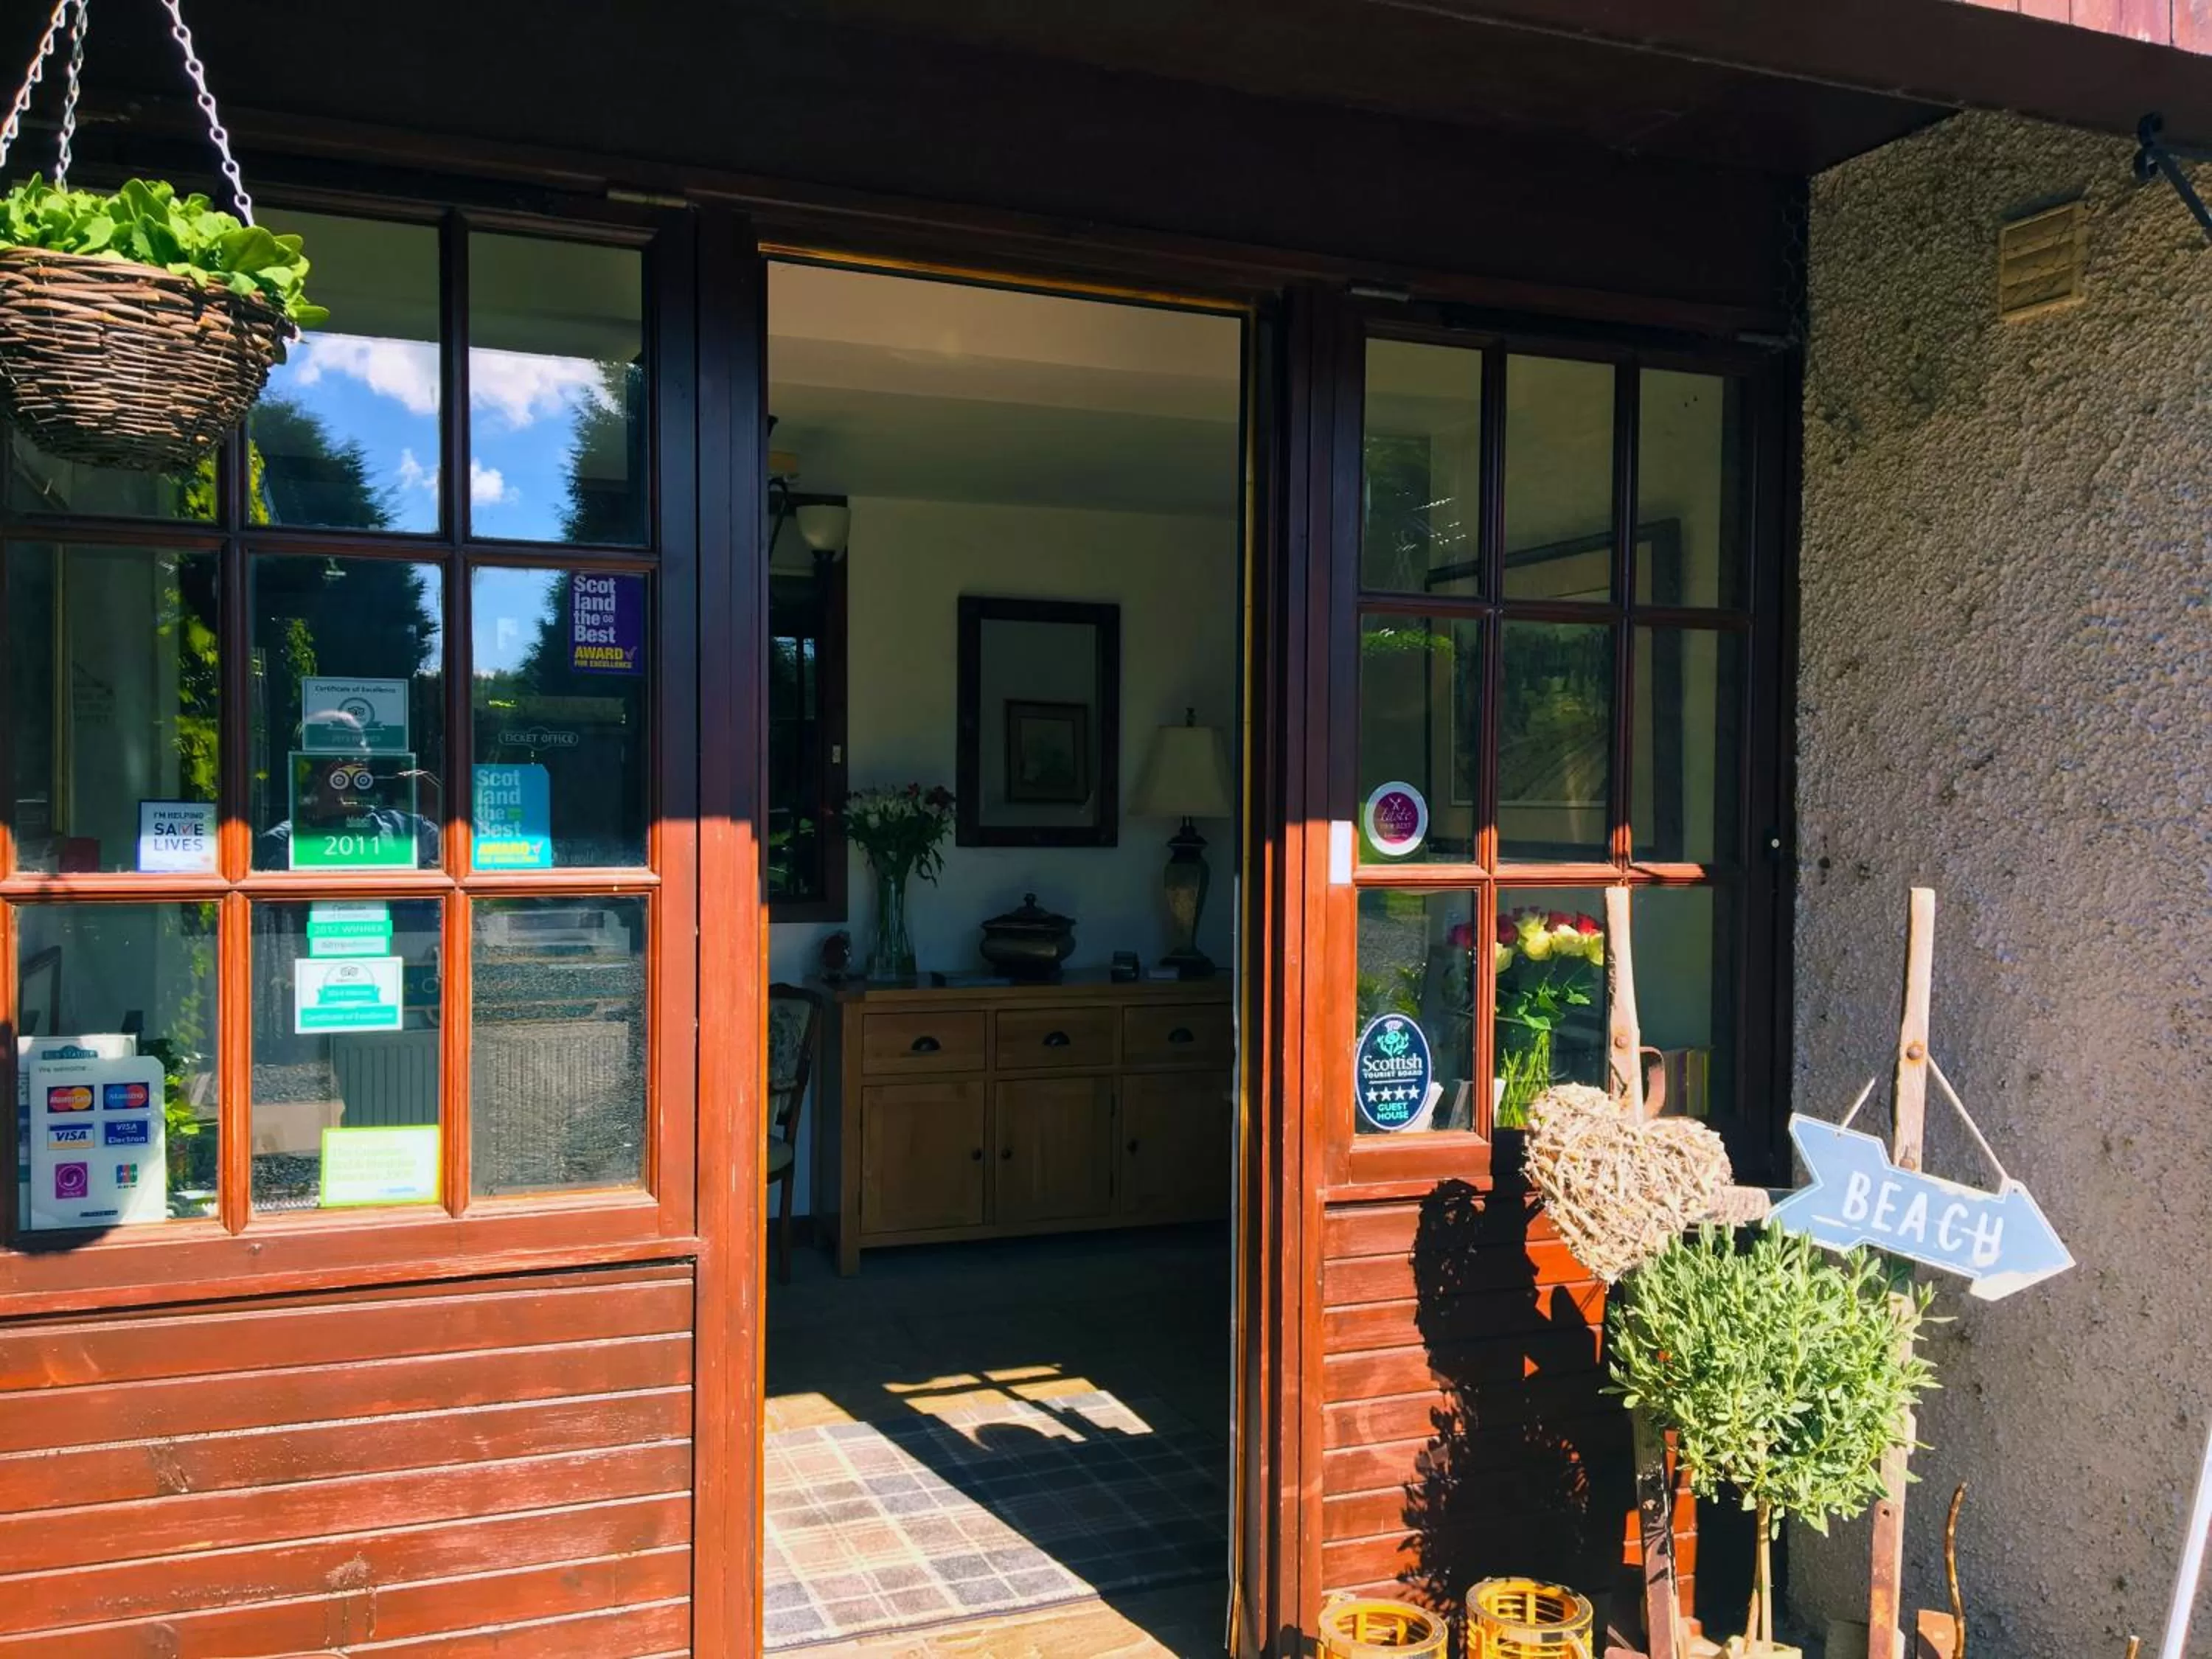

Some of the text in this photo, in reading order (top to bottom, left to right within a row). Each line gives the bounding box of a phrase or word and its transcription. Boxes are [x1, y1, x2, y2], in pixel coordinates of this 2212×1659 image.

[574, 575, 616, 593] Scot
[574, 592, 616, 611] land
[574, 611, 600, 625] the
[574, 625, 616, 643] Best
[575, 646, 624, 659] AWARD
[477, 769, 520, 787] Scot
[478, 785, 521, 804] land
[476, 804, 505, 821] the
[477, 821, 521, 838] Best
[153, 838, 204, 851] LIVES
[324, 835, 380, 855] 2011
[341, 924, 384, 933] WINNER
[1363, 1053, 1422, 1071] Scottish
[1363, 1071, 1396, 1079] TOURIST
[1377, 1102, 1408, 1111] GUEST
[1377, 1111, 1409, 1121] HOUSE
[116, 1123, 138, 1131] VISA
[55, 1131, 86, 1141] VISA
[108, 1135, 147, 1144] Electron
[1842, 1170, 2004, 1267] BEACH
